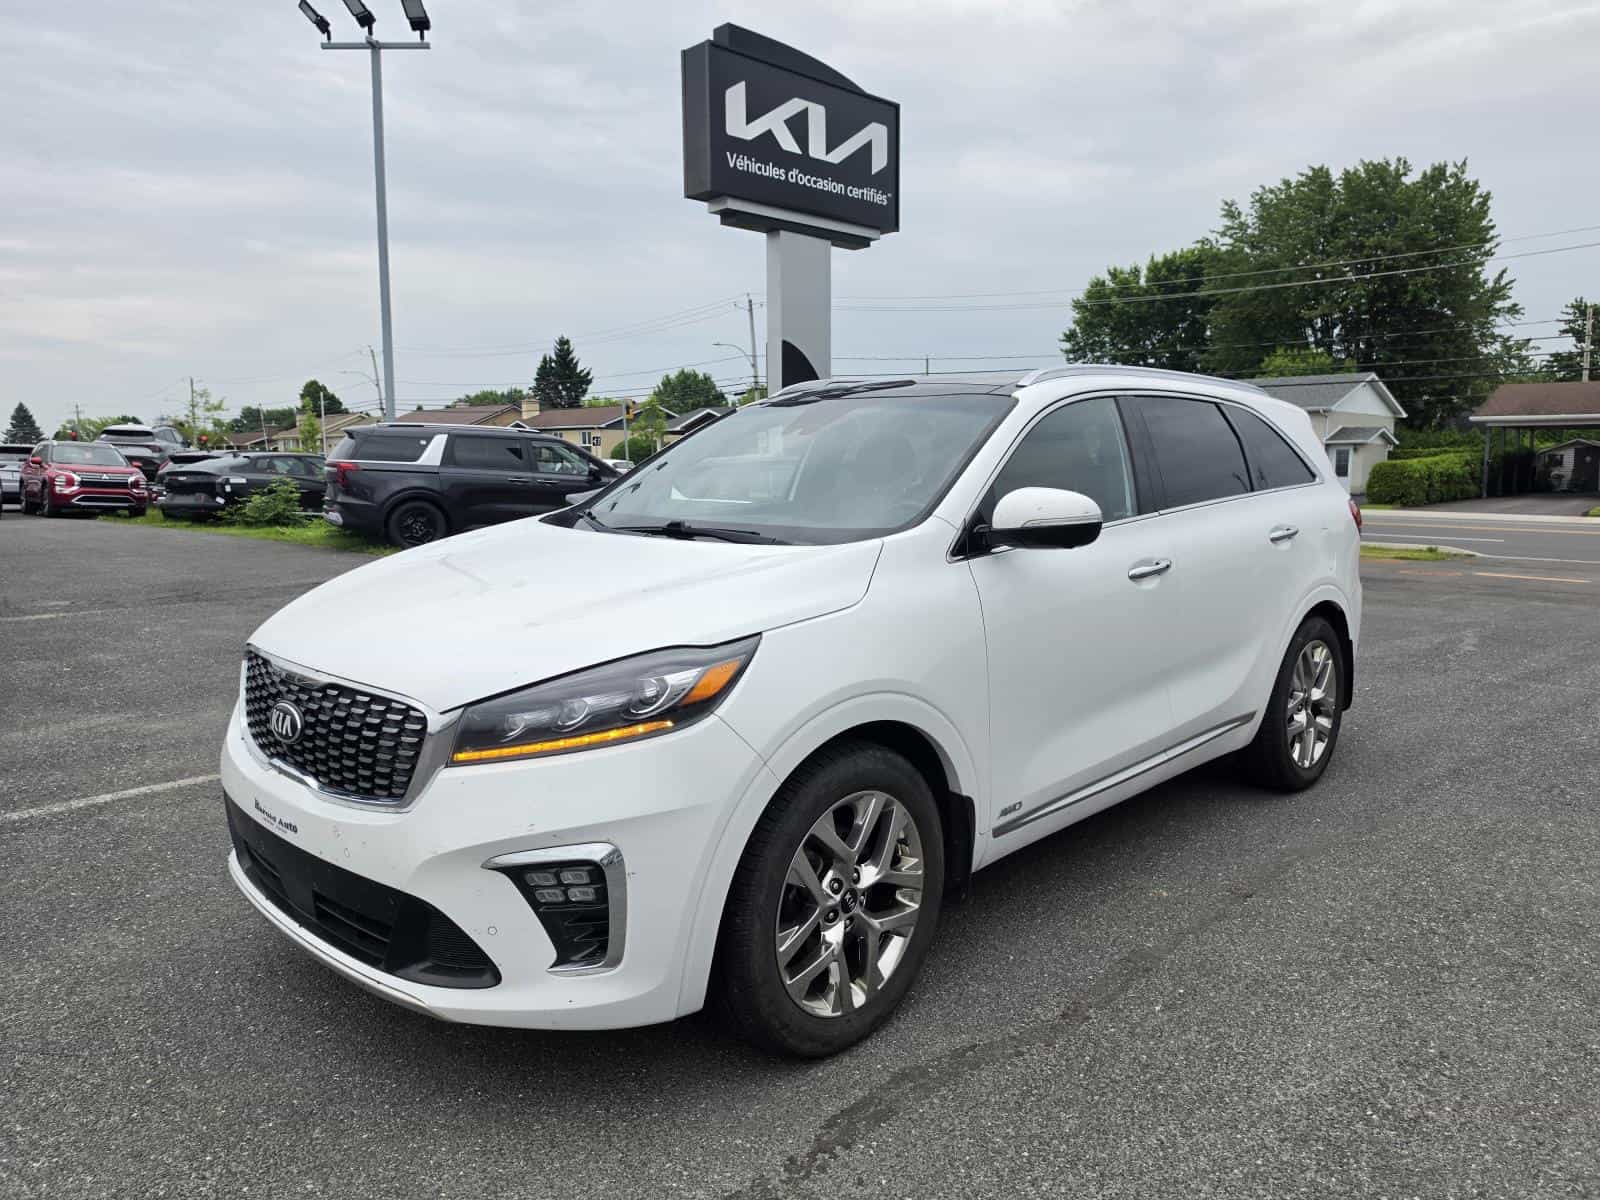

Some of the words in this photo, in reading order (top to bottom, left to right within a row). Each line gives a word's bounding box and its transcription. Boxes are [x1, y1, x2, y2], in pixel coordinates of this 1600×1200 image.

[726, 152, 786, 180] Véhicules
[788, 168, 845, 195] d'occasion
[272, 709, 293, 737] KIA
[278, 818, 298, 834] Auto
